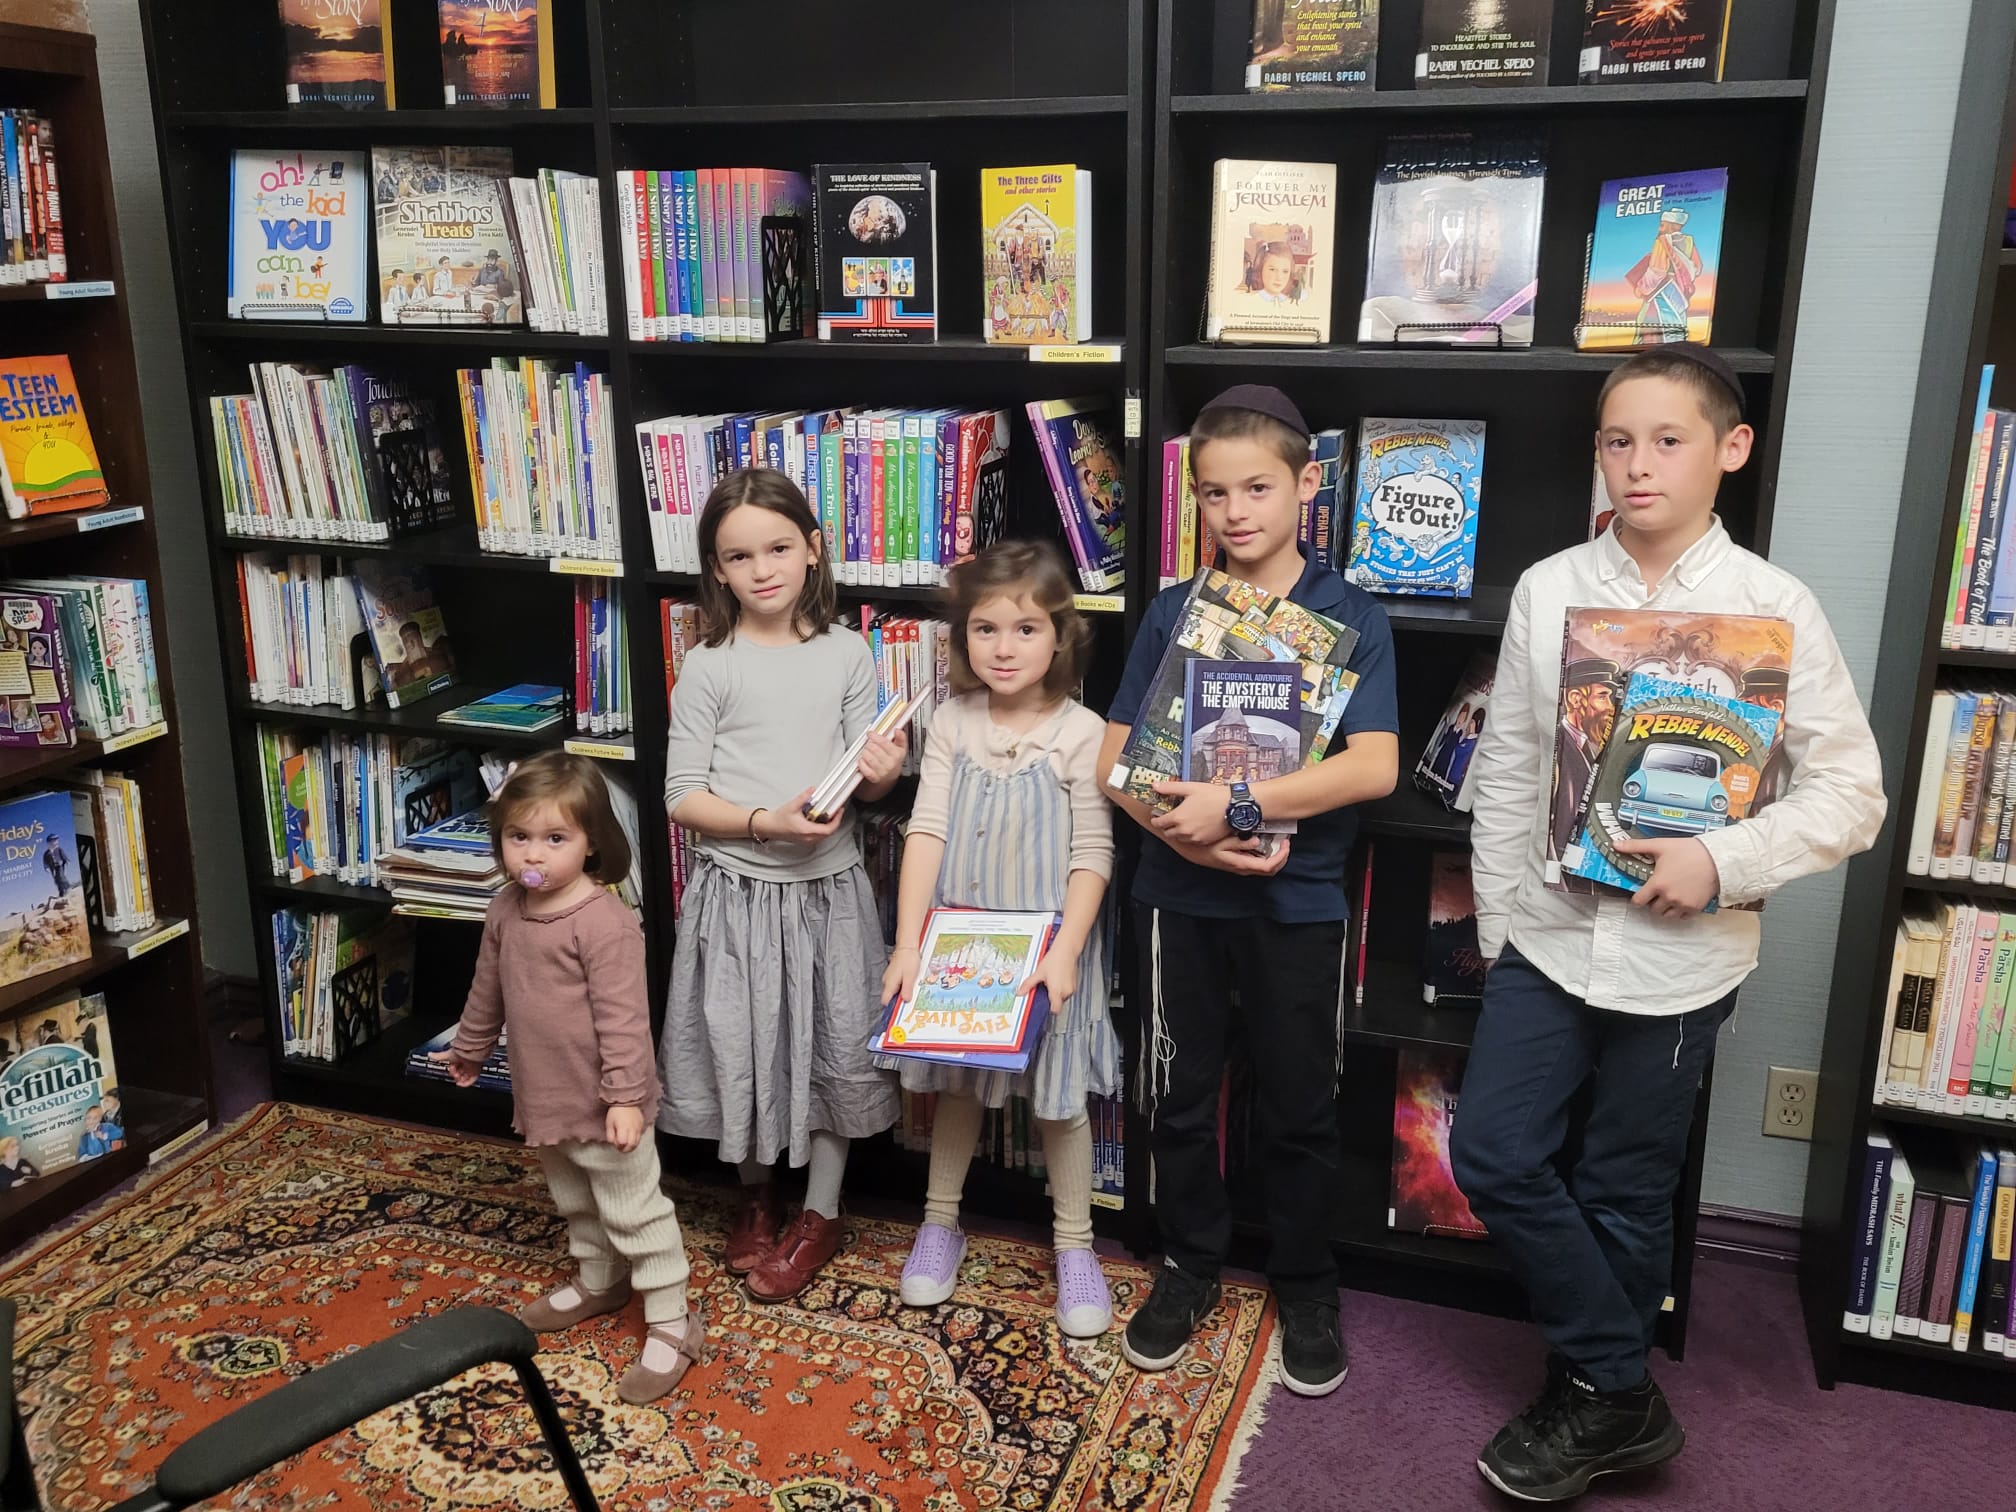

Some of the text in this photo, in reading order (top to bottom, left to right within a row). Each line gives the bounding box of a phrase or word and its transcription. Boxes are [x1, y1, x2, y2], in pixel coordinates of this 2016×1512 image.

[1297, 11, 1358, 21] Enlightening stories
[1297, 21, 1363, 32] that boost your spirit
[1296, 32, 1337, 41] and enhance
[1431, 44, 1439, 52] TO
[1440, 43, 1475, 52] ENCOURAGE
[1476, 42, 1490, 50] AND
[1506, 41, 1519, 49] THE
[1455, 33, 1512, 42] HEARTFELT STORIES
[1296, 44, 1338, 53] your emunah
[1429, 57, 1536, 72] RABBI YECHIEL SPERO
[1602, 57, 1706, 75] RABBI YECHIEL SPERO
[1264, 71, 1367, 83] RABBI YECHIEL SPERO
[260, 153, 305, 193] oh!
[881, 174, 922, 182] KINDNESS
[998, 174, 1062, 186] The Three Gifts
[1397, 171, 1409, 179] The
[1410, 170, 1436, 180] Jewish
[1468, 169, 1501, 178] Through
[1502, 168, 1522, 177] Time
[1005, 187, 1017, 195] and
[1036, 186, 1056, 194] stories
[1236, 181, 1328, 193] FOREVER MY
[1618, 184, 1665, 203] GREAT
[280, 189, 346, 216] the kid
[400, 201, 494, 224] Shabbos
[1229, 192, 1328, 215] JERUSALEM
[1616, 199, 1662, 218] EAGLE
[422, 221, 475, 238] Treats
[635, 183, 648, 261] A Story A Day
[647, 183, 661, 261] A Story A Day
[661, 183, 674, 261] A Story A Day
[674, 183, 686, 261] A Story A Day
[686, 183, 698, 261] A Story A Day
[260, 219, 332, 251] YOU
[257, 254, 304, 274] can
[1047, 350, 1080, 358] Children's
[1, 373, 59, 398] TEEN
[0, 394, 78, 422] ESTEEM
[1370, 432, 1450, 460] REBBE MENDEL
[647, 469, 655, 481] BIG
[808, 452, 819, 484] First
[944, 444, 955, 495] GOOD YOM TOV
[664, 472, 674, 503] MOMENT
[680, 485, 688, 510] MIDDLE
[825, 456, 835, 516] Classic Trio
[845, 480, 855, 527] Honig's Cakes
[1380, 485, 1455, 511] Figure
[1317, 505, 1330, 550] OPERATION
[1386, 504, 1459, 530] It Out!
[1369, 560, 1397, 575] STORIES
[1418, 569, 1434, 577] JUST
[1435, 562, 1456, 574] CAN'T
[1971, 536, 1997, 601] The Book of
[938, 658, 948, 685] Purple
[1203, 672, 1293, 682] THE ACCIDENTAL ADVENTURERS
[1202, 681, 1292, 697] THE MYSTERY OF
[1202, 694, 1290, 710] THE EMPTY HOUSE
[1160, 728, 1170, 736] An
[1626, 713, 1752, 758] REBBE MENDEL
[1986, 741, 2012, 826] Let My World Survive
[0, 819, 44, 841] iday's
[1942, 806, 1958, 833] Nation
[2000, 799, 2016, 840] Be Warned
[18, 868, 33, 880] CITY
[1974, 948, 1991, 983] Parsha
[1994, 948, 2011, 984] Parsha
[958, 1014, 1010, 1035] Five
[1932, 1027, 1946, 1073] THE ARTSCROLL
[8, 1085, 91, 1123] Treasures
[22, 1114, 84, 1140] Power of Prayer
[1875, 1159, 1884, 1174] THE
[1870, 1174, 1882, 1195] Family
[1983, 1174, 1992, 1185] The
[1867, 1195, 1880, 1229] MIDRASH
[1895, 1193, 1906, 1214] what
[1998, 1193, 2011, 1254] GOOD SHABBOS
[1865, 1229, 1874, 1246] SAYS
